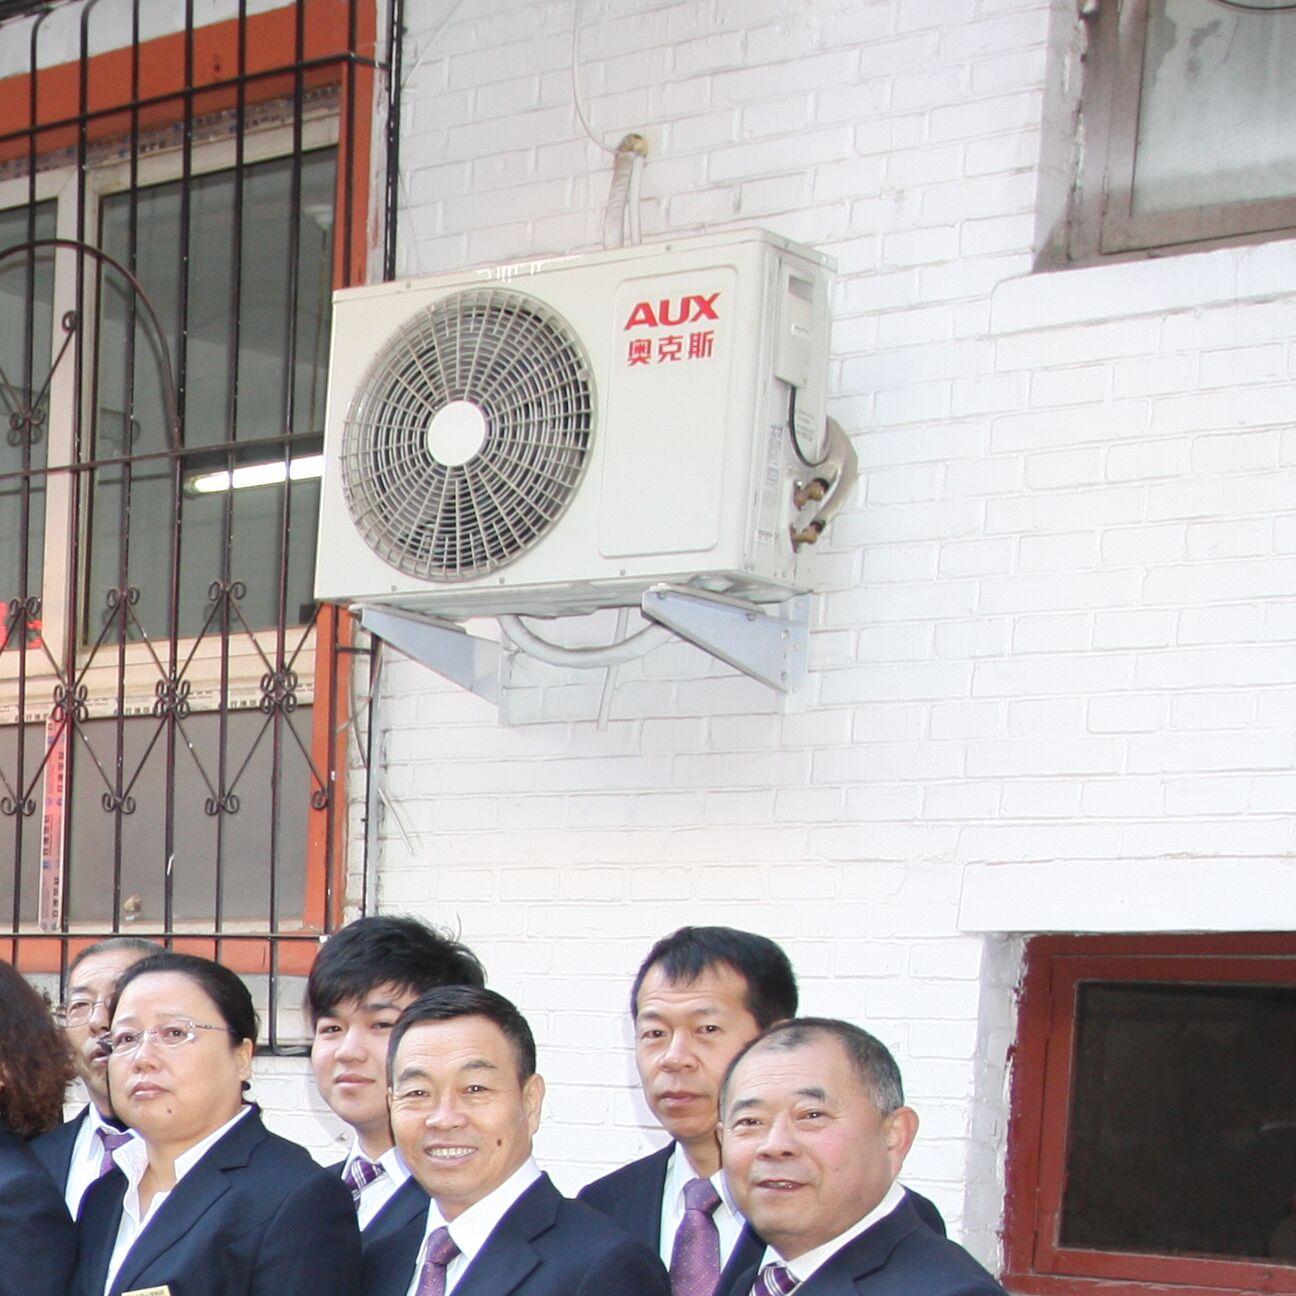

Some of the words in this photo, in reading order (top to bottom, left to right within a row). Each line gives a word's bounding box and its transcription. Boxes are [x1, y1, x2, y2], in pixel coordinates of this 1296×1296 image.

[624, 292, 721, 330] AUX
[627, 330, 715, 366] 奥克斯
